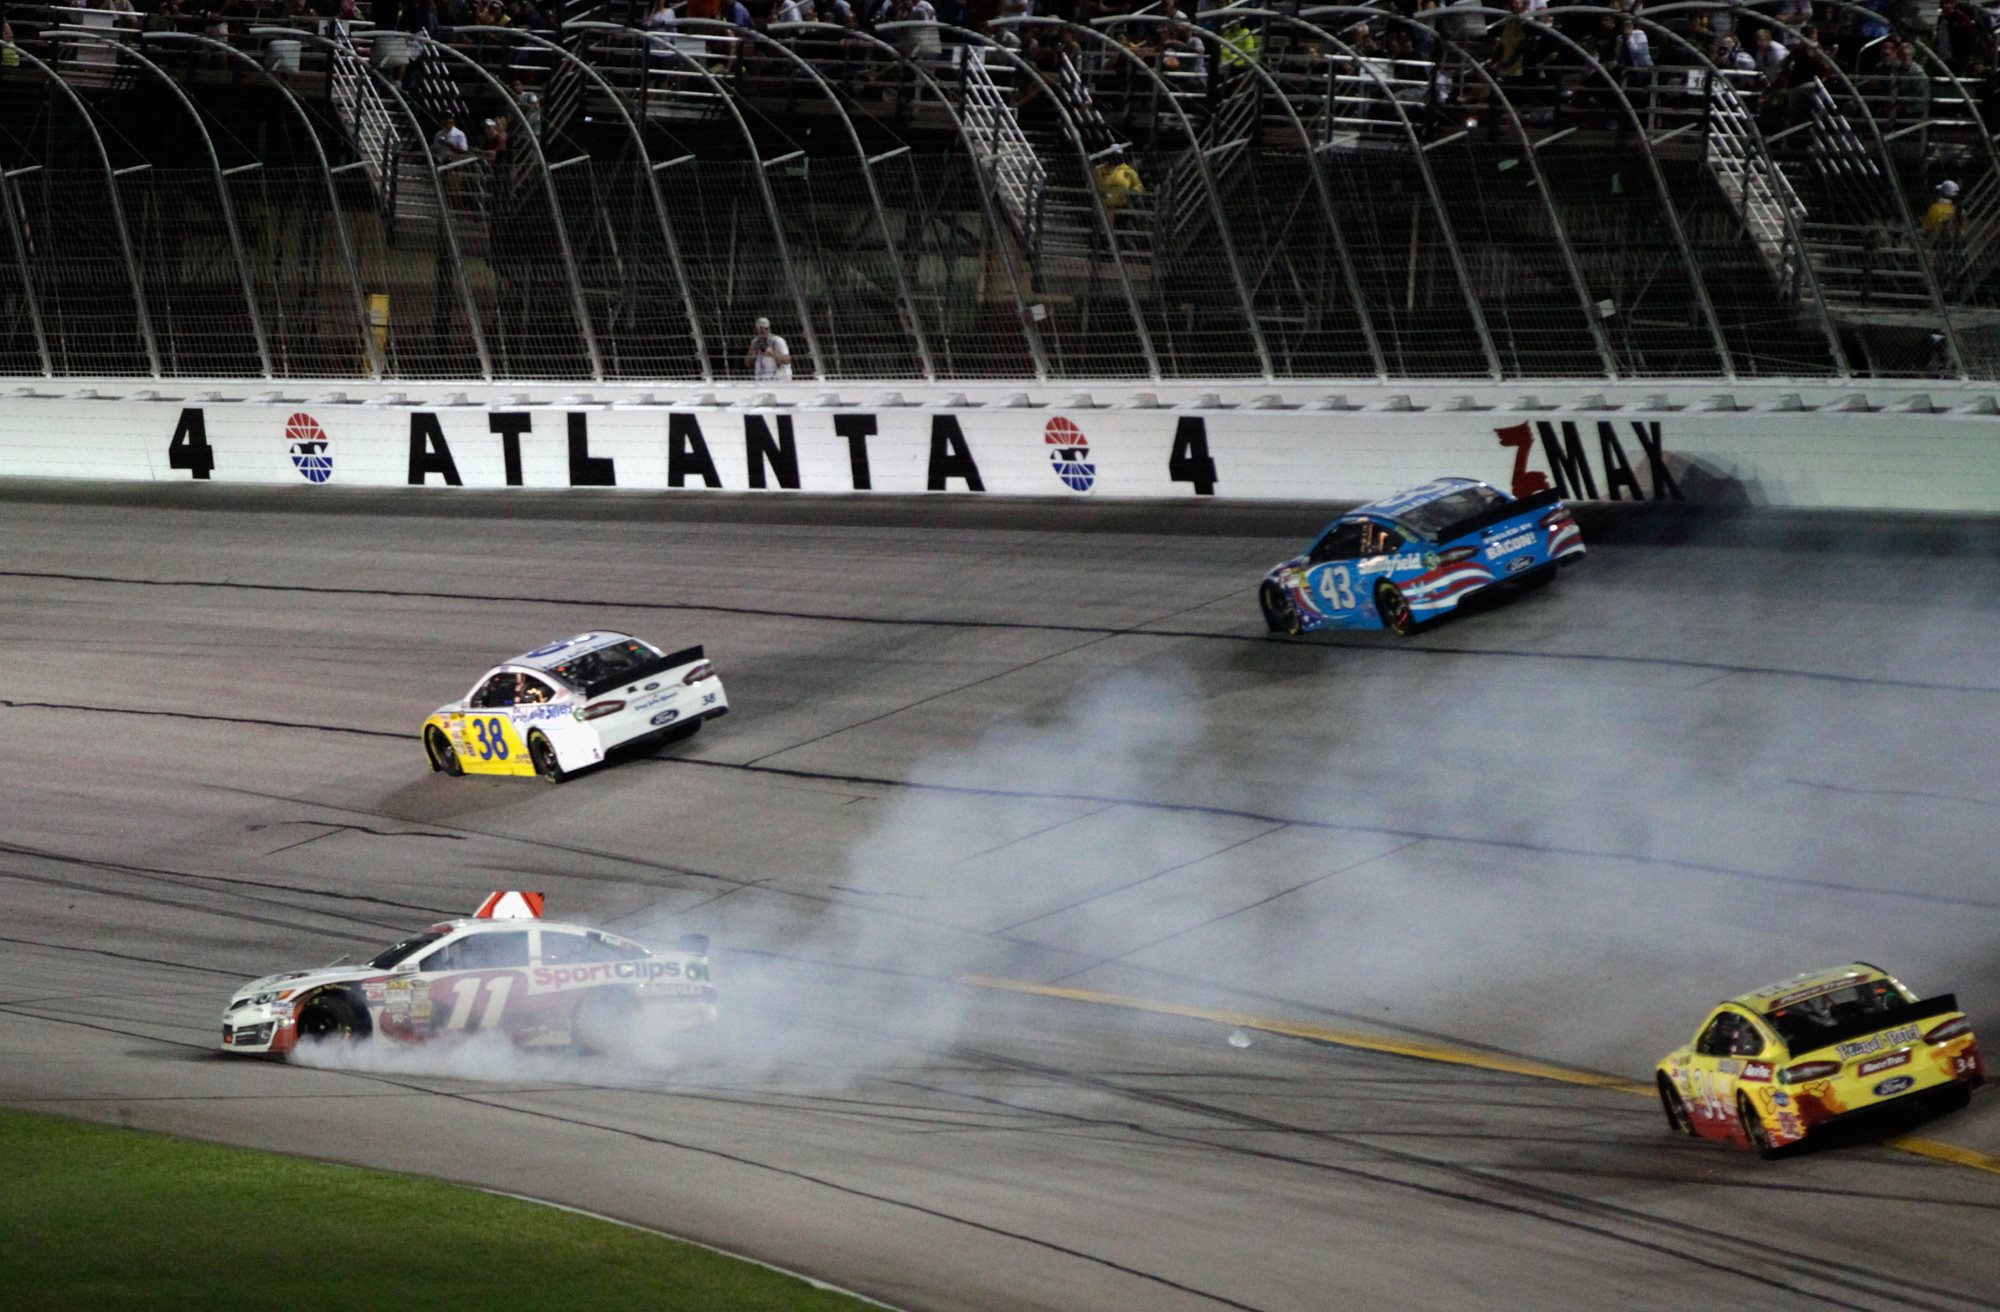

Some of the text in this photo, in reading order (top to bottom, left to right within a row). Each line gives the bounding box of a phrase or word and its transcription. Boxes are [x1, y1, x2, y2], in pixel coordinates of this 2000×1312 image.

[168, 407, 1219, 496] 4 ATLANTA 4
[1319, 565, 1356, 610] 43
[473, 718, 509, 760] 38
[448, 975, 515, 1029] 11
[1877, 1077, 1912, 1095] Ford
[1956, 1055, 1976, 1074] 34
